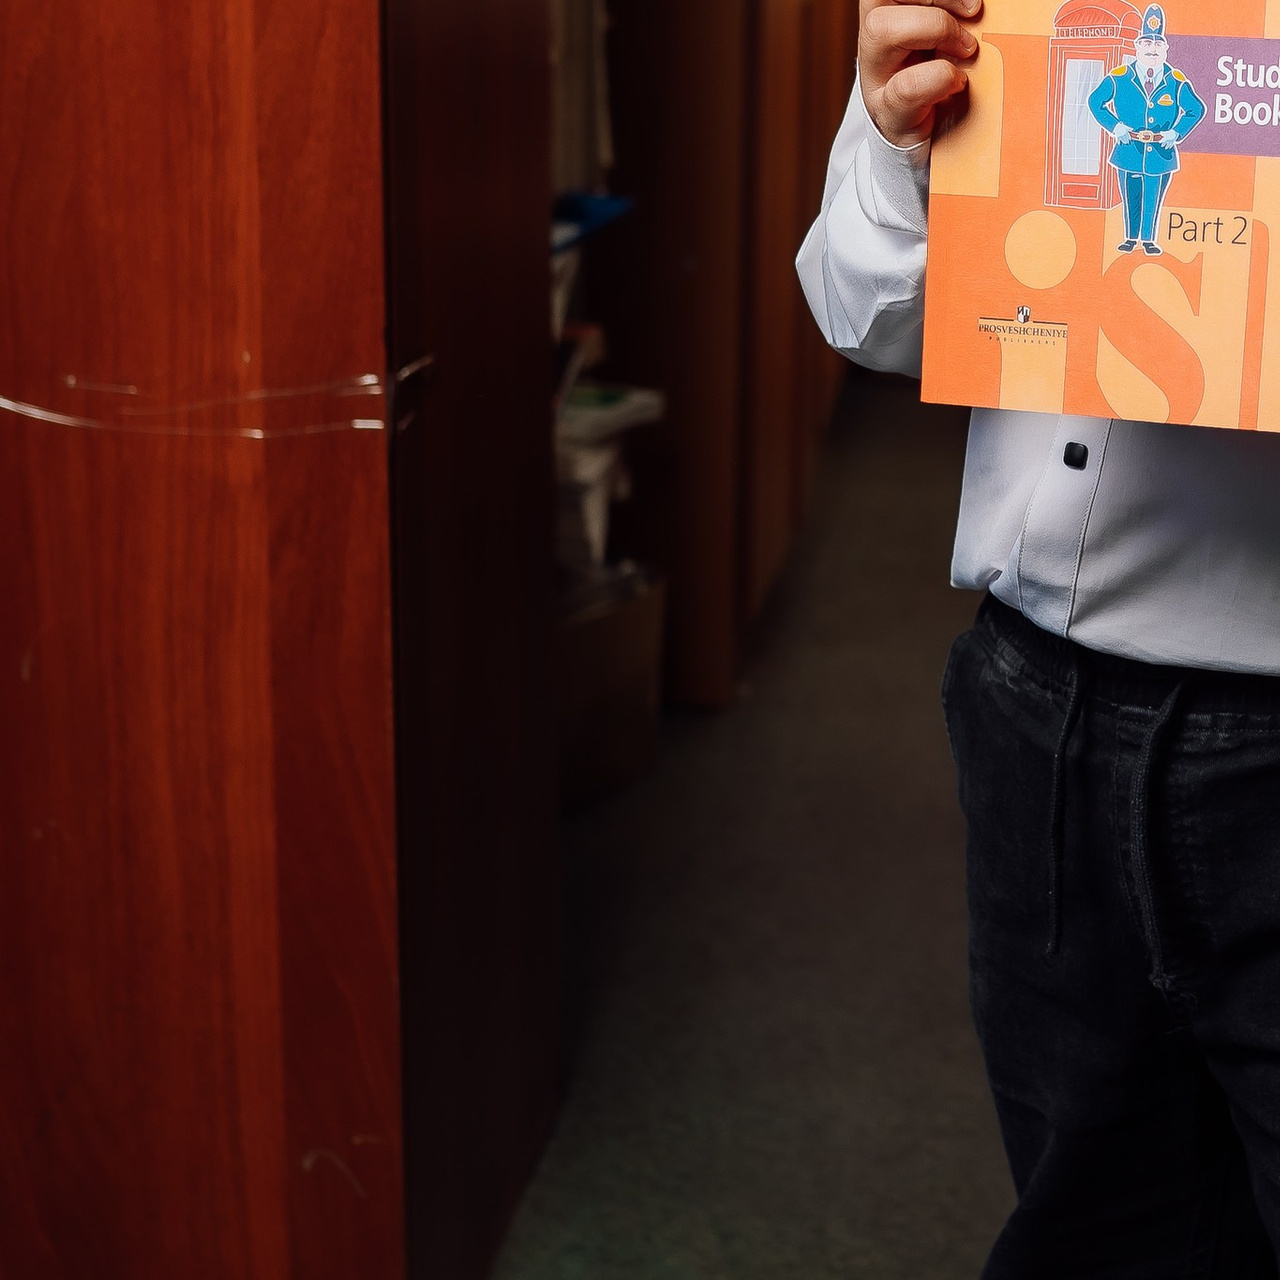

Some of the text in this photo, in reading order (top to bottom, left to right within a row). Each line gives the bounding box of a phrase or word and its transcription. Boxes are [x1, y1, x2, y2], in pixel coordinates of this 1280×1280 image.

[1061, 27, 1115, 38] TELEPHONE
[1167, 212, 1249, 245] Part 2
[978, 323, 1068, 338] PROSVESHCHENIYE
